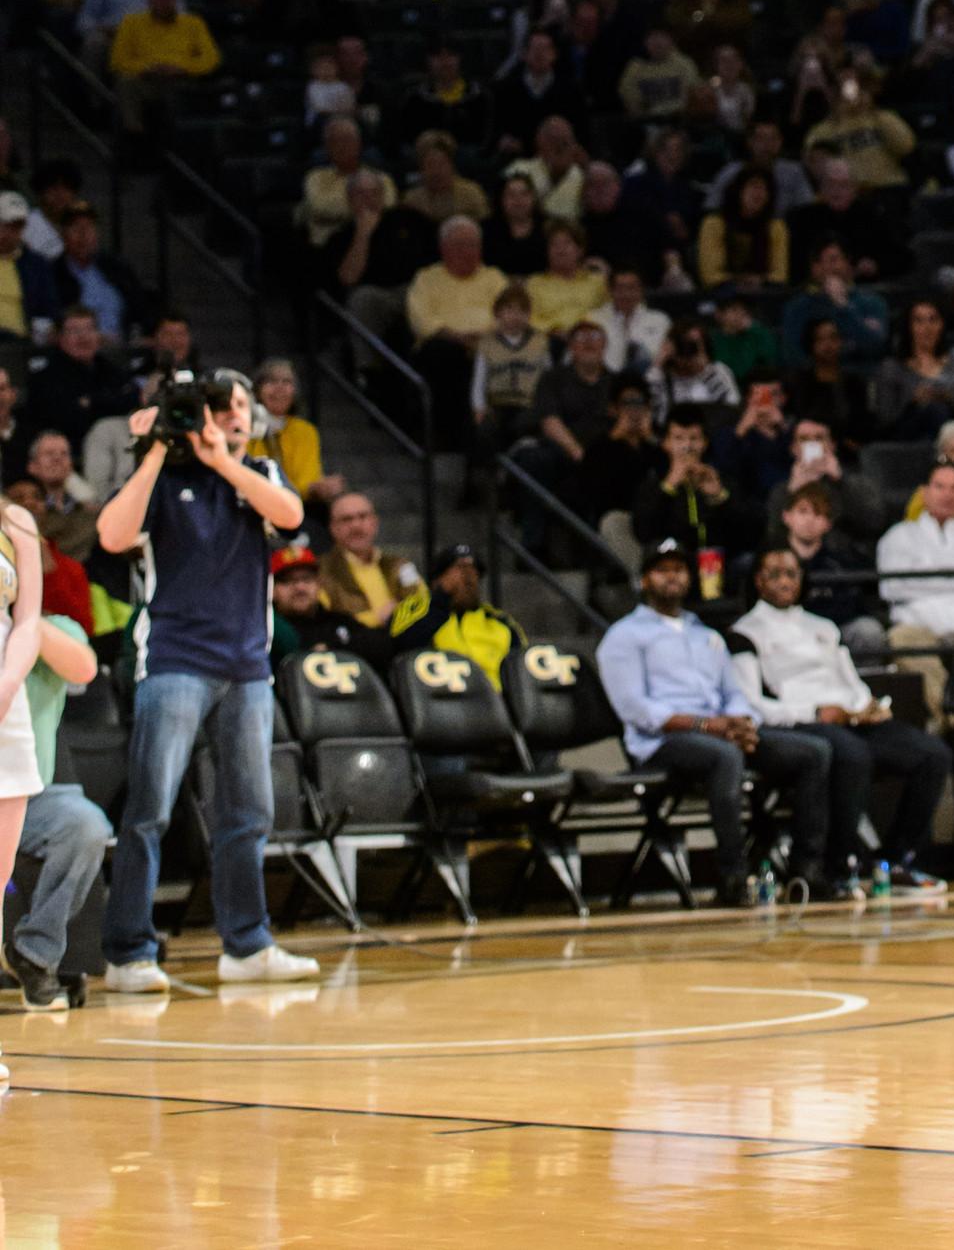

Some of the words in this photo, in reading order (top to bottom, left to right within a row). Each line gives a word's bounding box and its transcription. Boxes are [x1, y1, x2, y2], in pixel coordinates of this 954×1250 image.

[303, 652, 360, 693] GT
[414, 651, 471, 692] GT
[525, 645, 580, 685] GT
